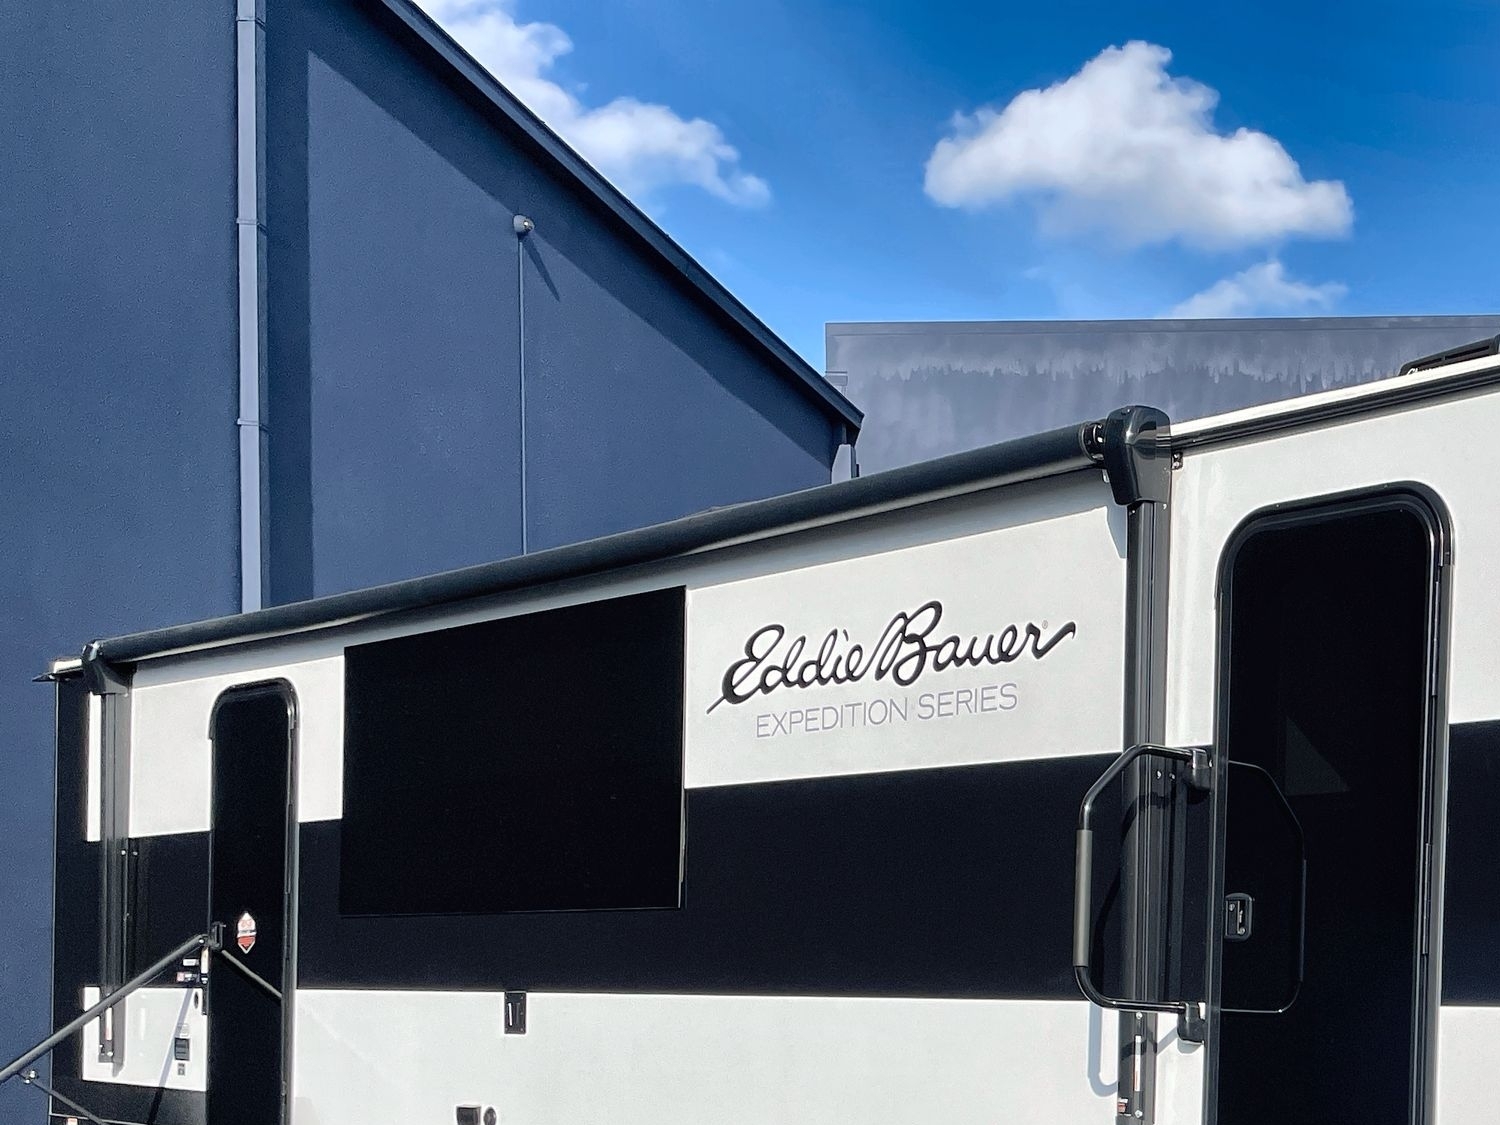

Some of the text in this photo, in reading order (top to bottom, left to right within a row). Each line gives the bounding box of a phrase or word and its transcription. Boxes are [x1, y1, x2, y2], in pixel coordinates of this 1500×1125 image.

[706, 600, 1077, 715] Eddie Bauer
[756, 682, 1018, 739] EXPEDITION SERIES
